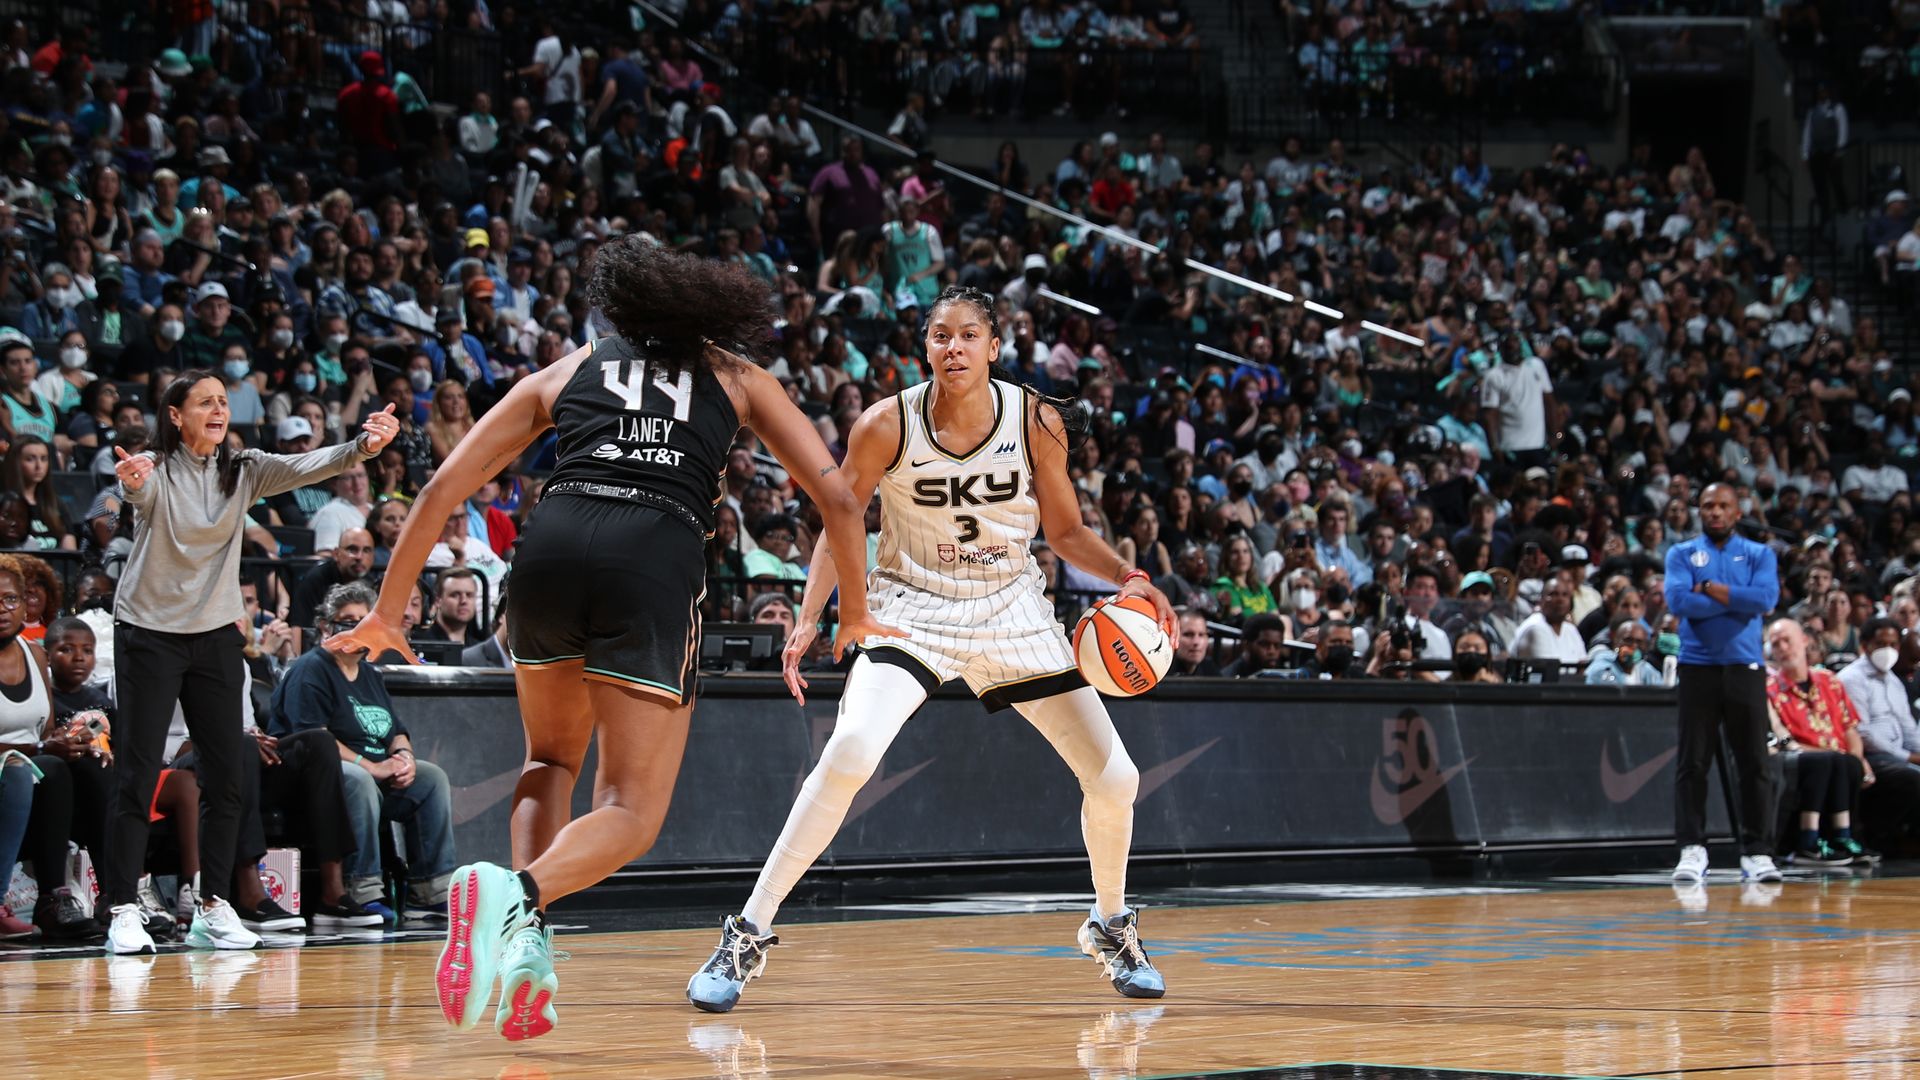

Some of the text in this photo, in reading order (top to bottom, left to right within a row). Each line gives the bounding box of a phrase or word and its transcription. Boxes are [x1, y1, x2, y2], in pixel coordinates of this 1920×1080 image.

[600, 359, 693, 422] 44
[617, 416, 674, 443] LANEY
[627, 448, 685, 466] AT&T
[910, 470, 1020, 508] SKY
[954, 514, 981, 544] 3
[1111, 638, 1149, 691] Wilson
[1382, 716, 1440, 784] 50
